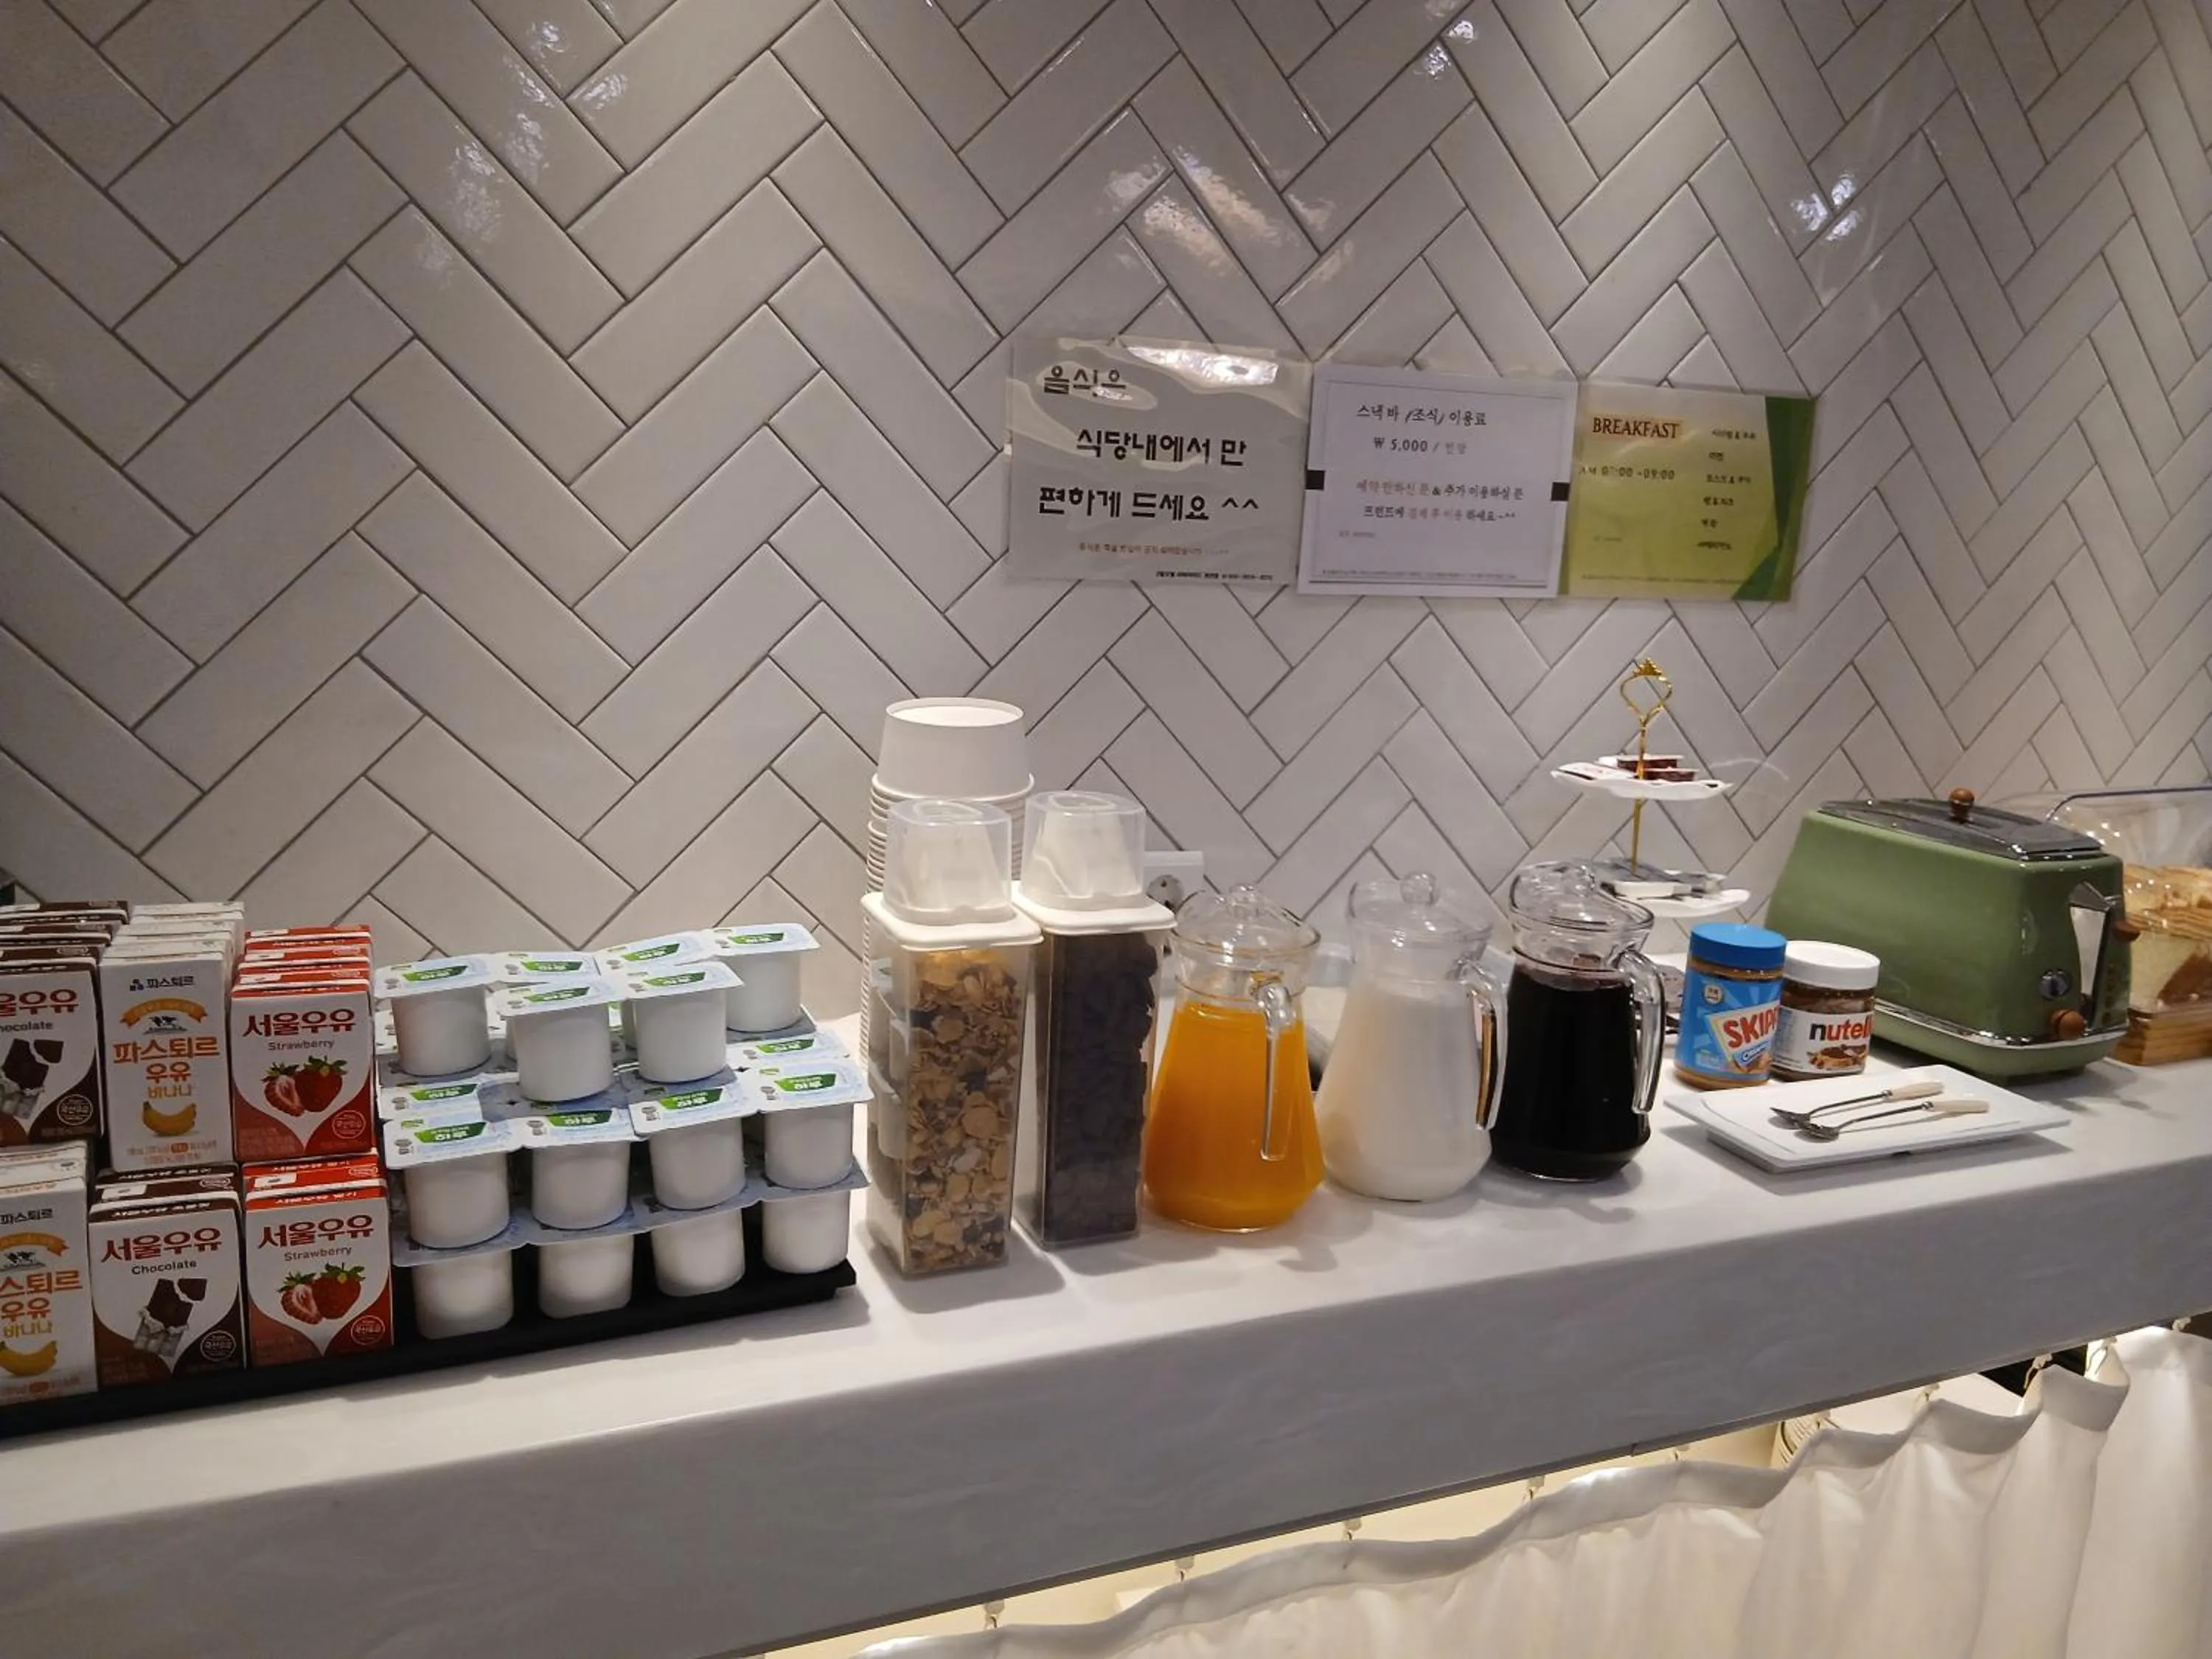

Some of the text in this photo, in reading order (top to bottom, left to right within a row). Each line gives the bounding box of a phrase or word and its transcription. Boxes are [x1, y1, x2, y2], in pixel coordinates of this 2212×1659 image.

[1449, 409, 1486, 426] 이용료
[1593, 417, 1680, 439] BREAKFAST
[1391, 439, 1428, 452] 5,000
[1039, 487, 1121, 517] 편하게
[1131, 492, 1208, 521] 드세요
[146, 975, 195, 989] 파스퇴르
[0, 989, 79, 1017] 울우유
[242, 1009, 356, 1037] 서울우유
[1809, 1015, 1874, 1040] nutell
[113, 1037, 220, 1063] 파스퇴르
[268, 1040, 335, 1051] Strawberry
[145, 1061, 192, 1083] 우유
[257, 1214, 375, 1249] 서울우유
[101, 1228, 222, 1262] 서울우유
[284, 1247, 352, 1262] Strawberry
[131, 1259, 198, 1275] Chocolate
[0, 1270, 83, 1298] 스퇴르
[1, 1298, 51, 1322] 우유
